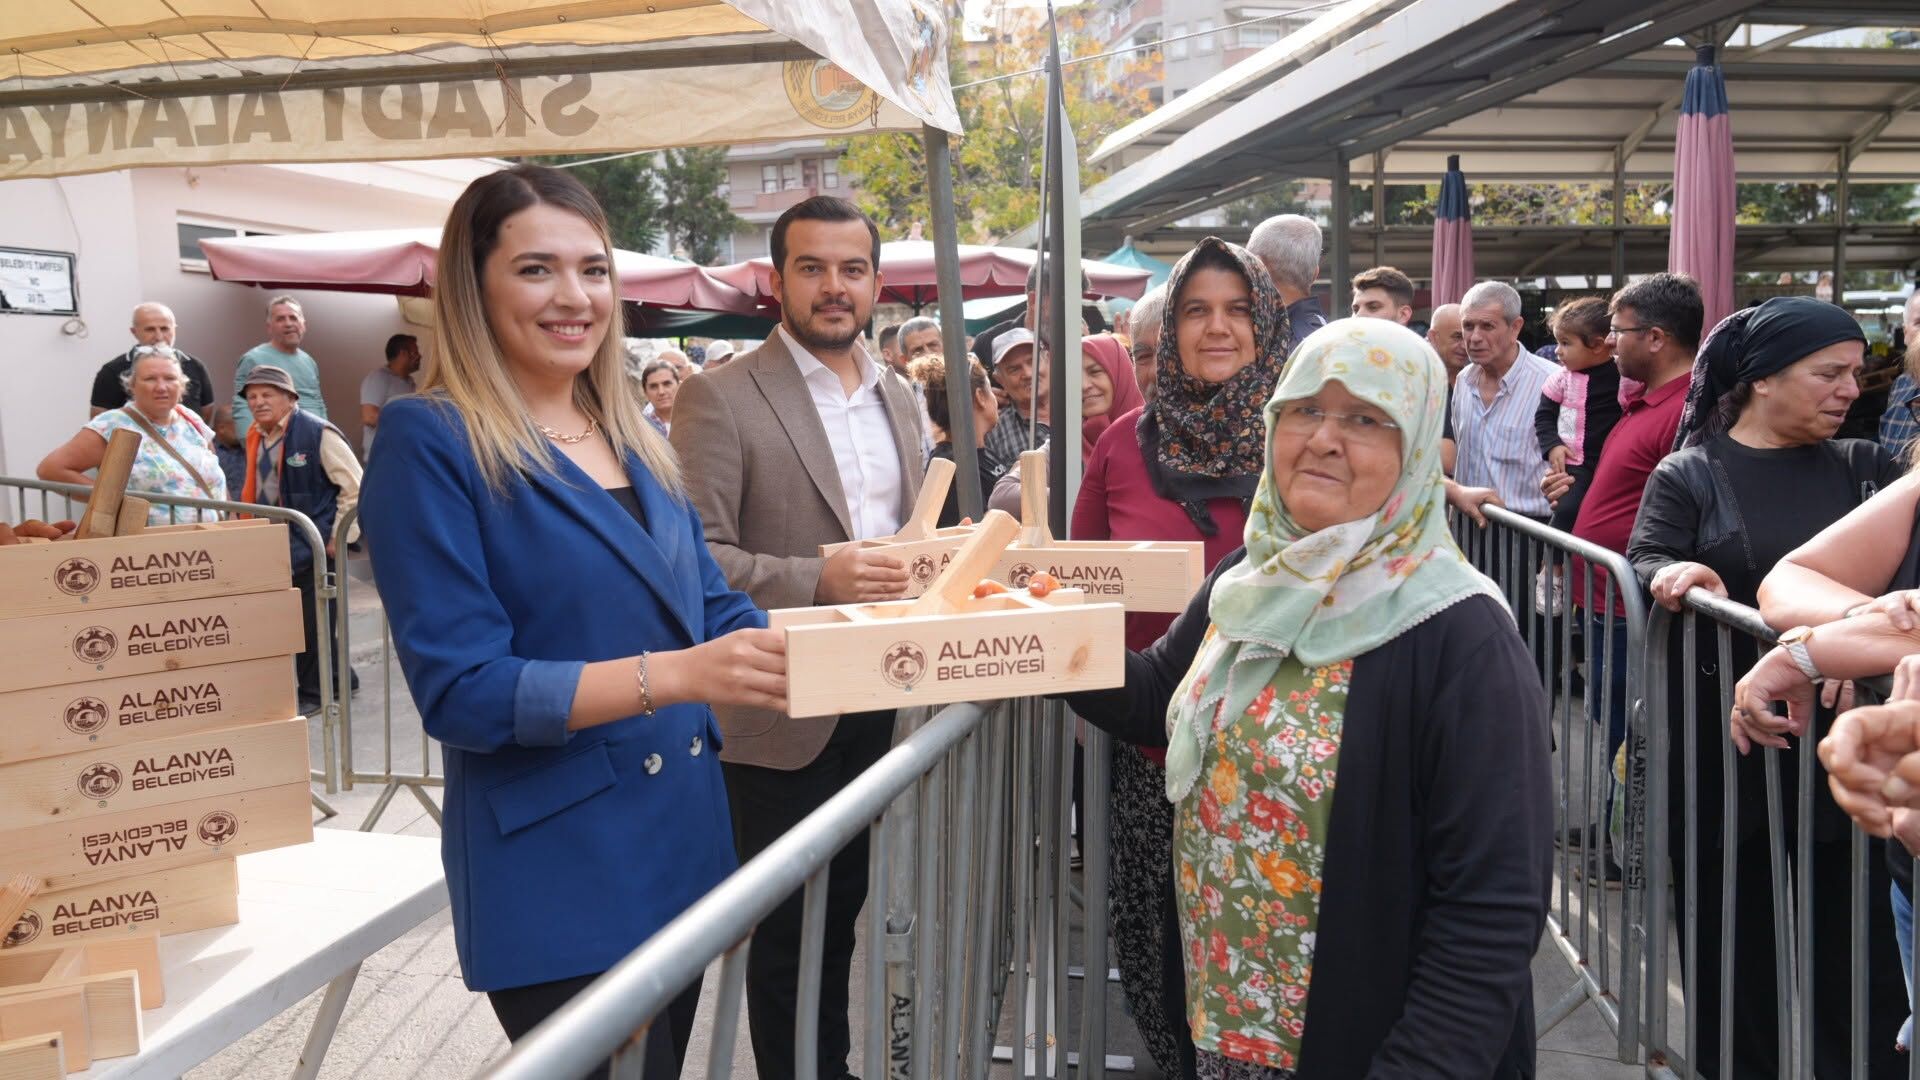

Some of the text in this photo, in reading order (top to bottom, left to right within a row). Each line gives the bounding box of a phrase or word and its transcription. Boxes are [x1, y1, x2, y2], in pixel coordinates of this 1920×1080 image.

[110, 549, 213, 573] ALANYA
[1049, 565, 1123, 580] ALANYA
[110, 565, 215, 589] BELEDİYESİ
[1060, 581, 1124, 594] EDİYESİ
[128, 615, 229, 640] ALANYA
[128, 631, 230, 656] BELEDİYESİ
[938, 634, 1043, 661] ALANYA
[937, 655, 1045, 681] BELEDİYESİ
[119, 682, 220, 710] ALANYA
[119, 698, 222, 726] BELEDİYESİ
[132, 747, 233, 776] ALANYA
[132, 763, 235, 791] BELEDİYESİ
[82, 819, 188, 850] BELEDİYESİ
[84, 834, 188, 866] ALANYA
[52, 890, 158, 921] ALANYA
[52, 906, 160, 936] BELEDİYESİ
[890, 992, 912, 1080] ALANY
